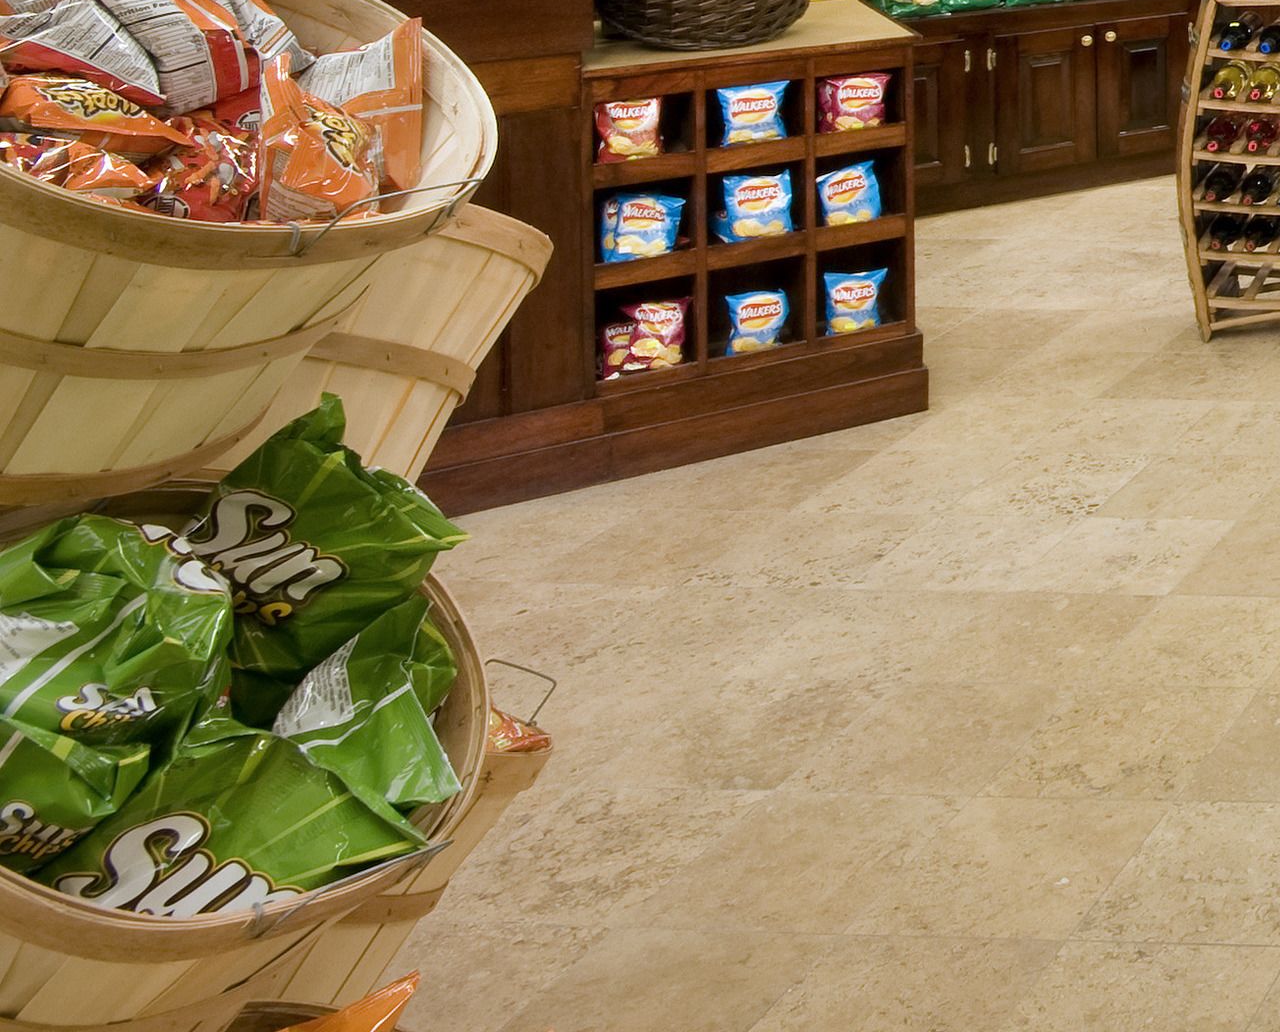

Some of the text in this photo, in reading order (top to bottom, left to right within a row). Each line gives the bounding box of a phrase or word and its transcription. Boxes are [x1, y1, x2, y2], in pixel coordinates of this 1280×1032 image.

[838, 85, 881, 100] WALKERS
[730, 96, 776, 114] WALKERS
[736, 185, 780, 202] WALKERS
[827, 175, 867, 198] WALKERS
[834, 285, 876, 303] WALKERS
[739, 302, 782, 320] WALKERS
[606, 322, 634, 337] WALK
[184, 489, 349, 601] Sun
